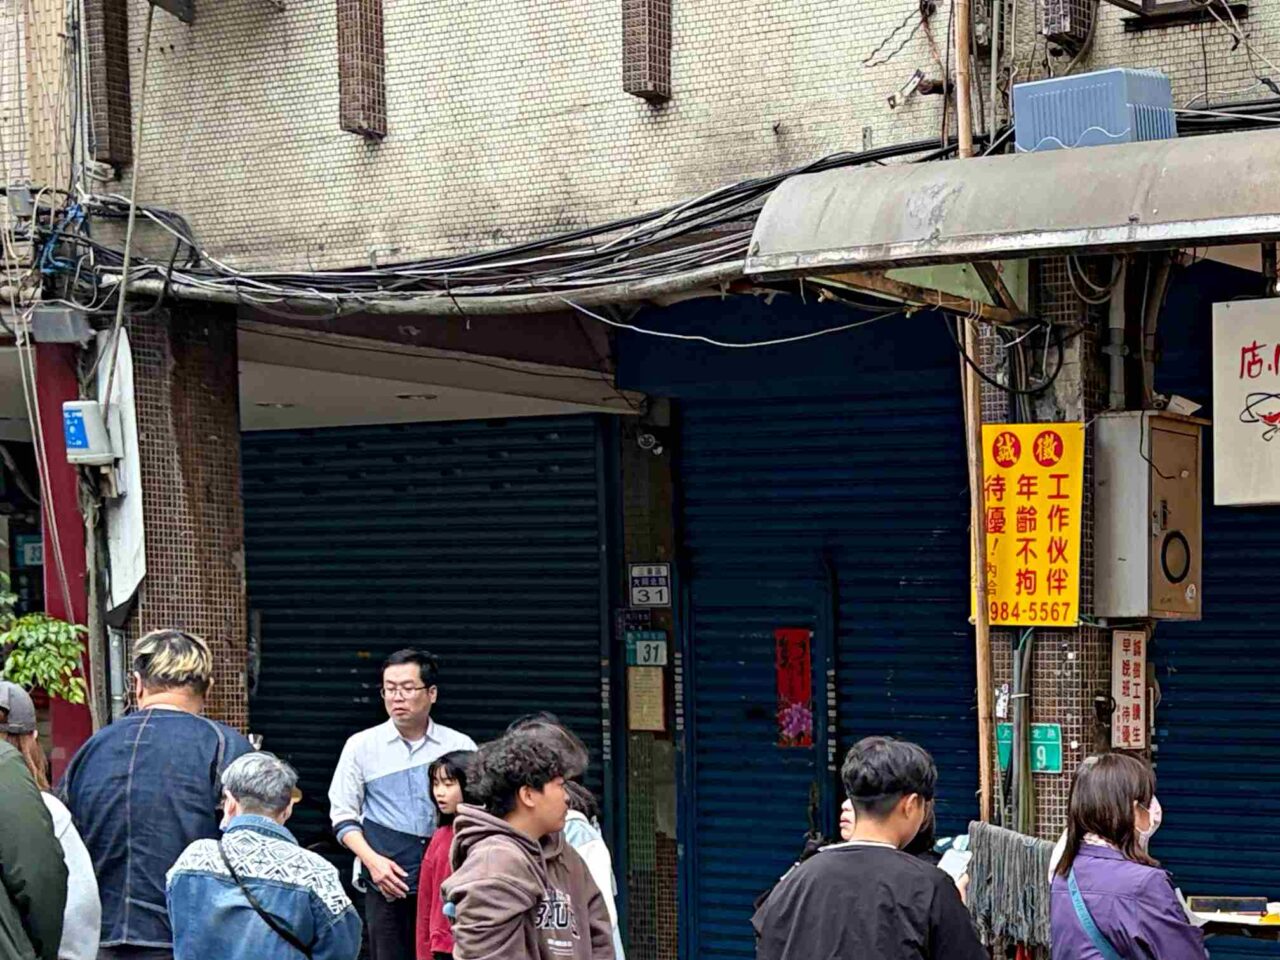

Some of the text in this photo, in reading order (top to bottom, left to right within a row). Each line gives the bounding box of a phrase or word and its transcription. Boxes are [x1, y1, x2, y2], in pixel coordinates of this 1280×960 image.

[1016, 473, 1038, 596] 年齡不拘
[1046, 473, 1070, 596] 工作伙伴
[638, 589, 663, 602] 31
[643, 643, 659, 663] 31
